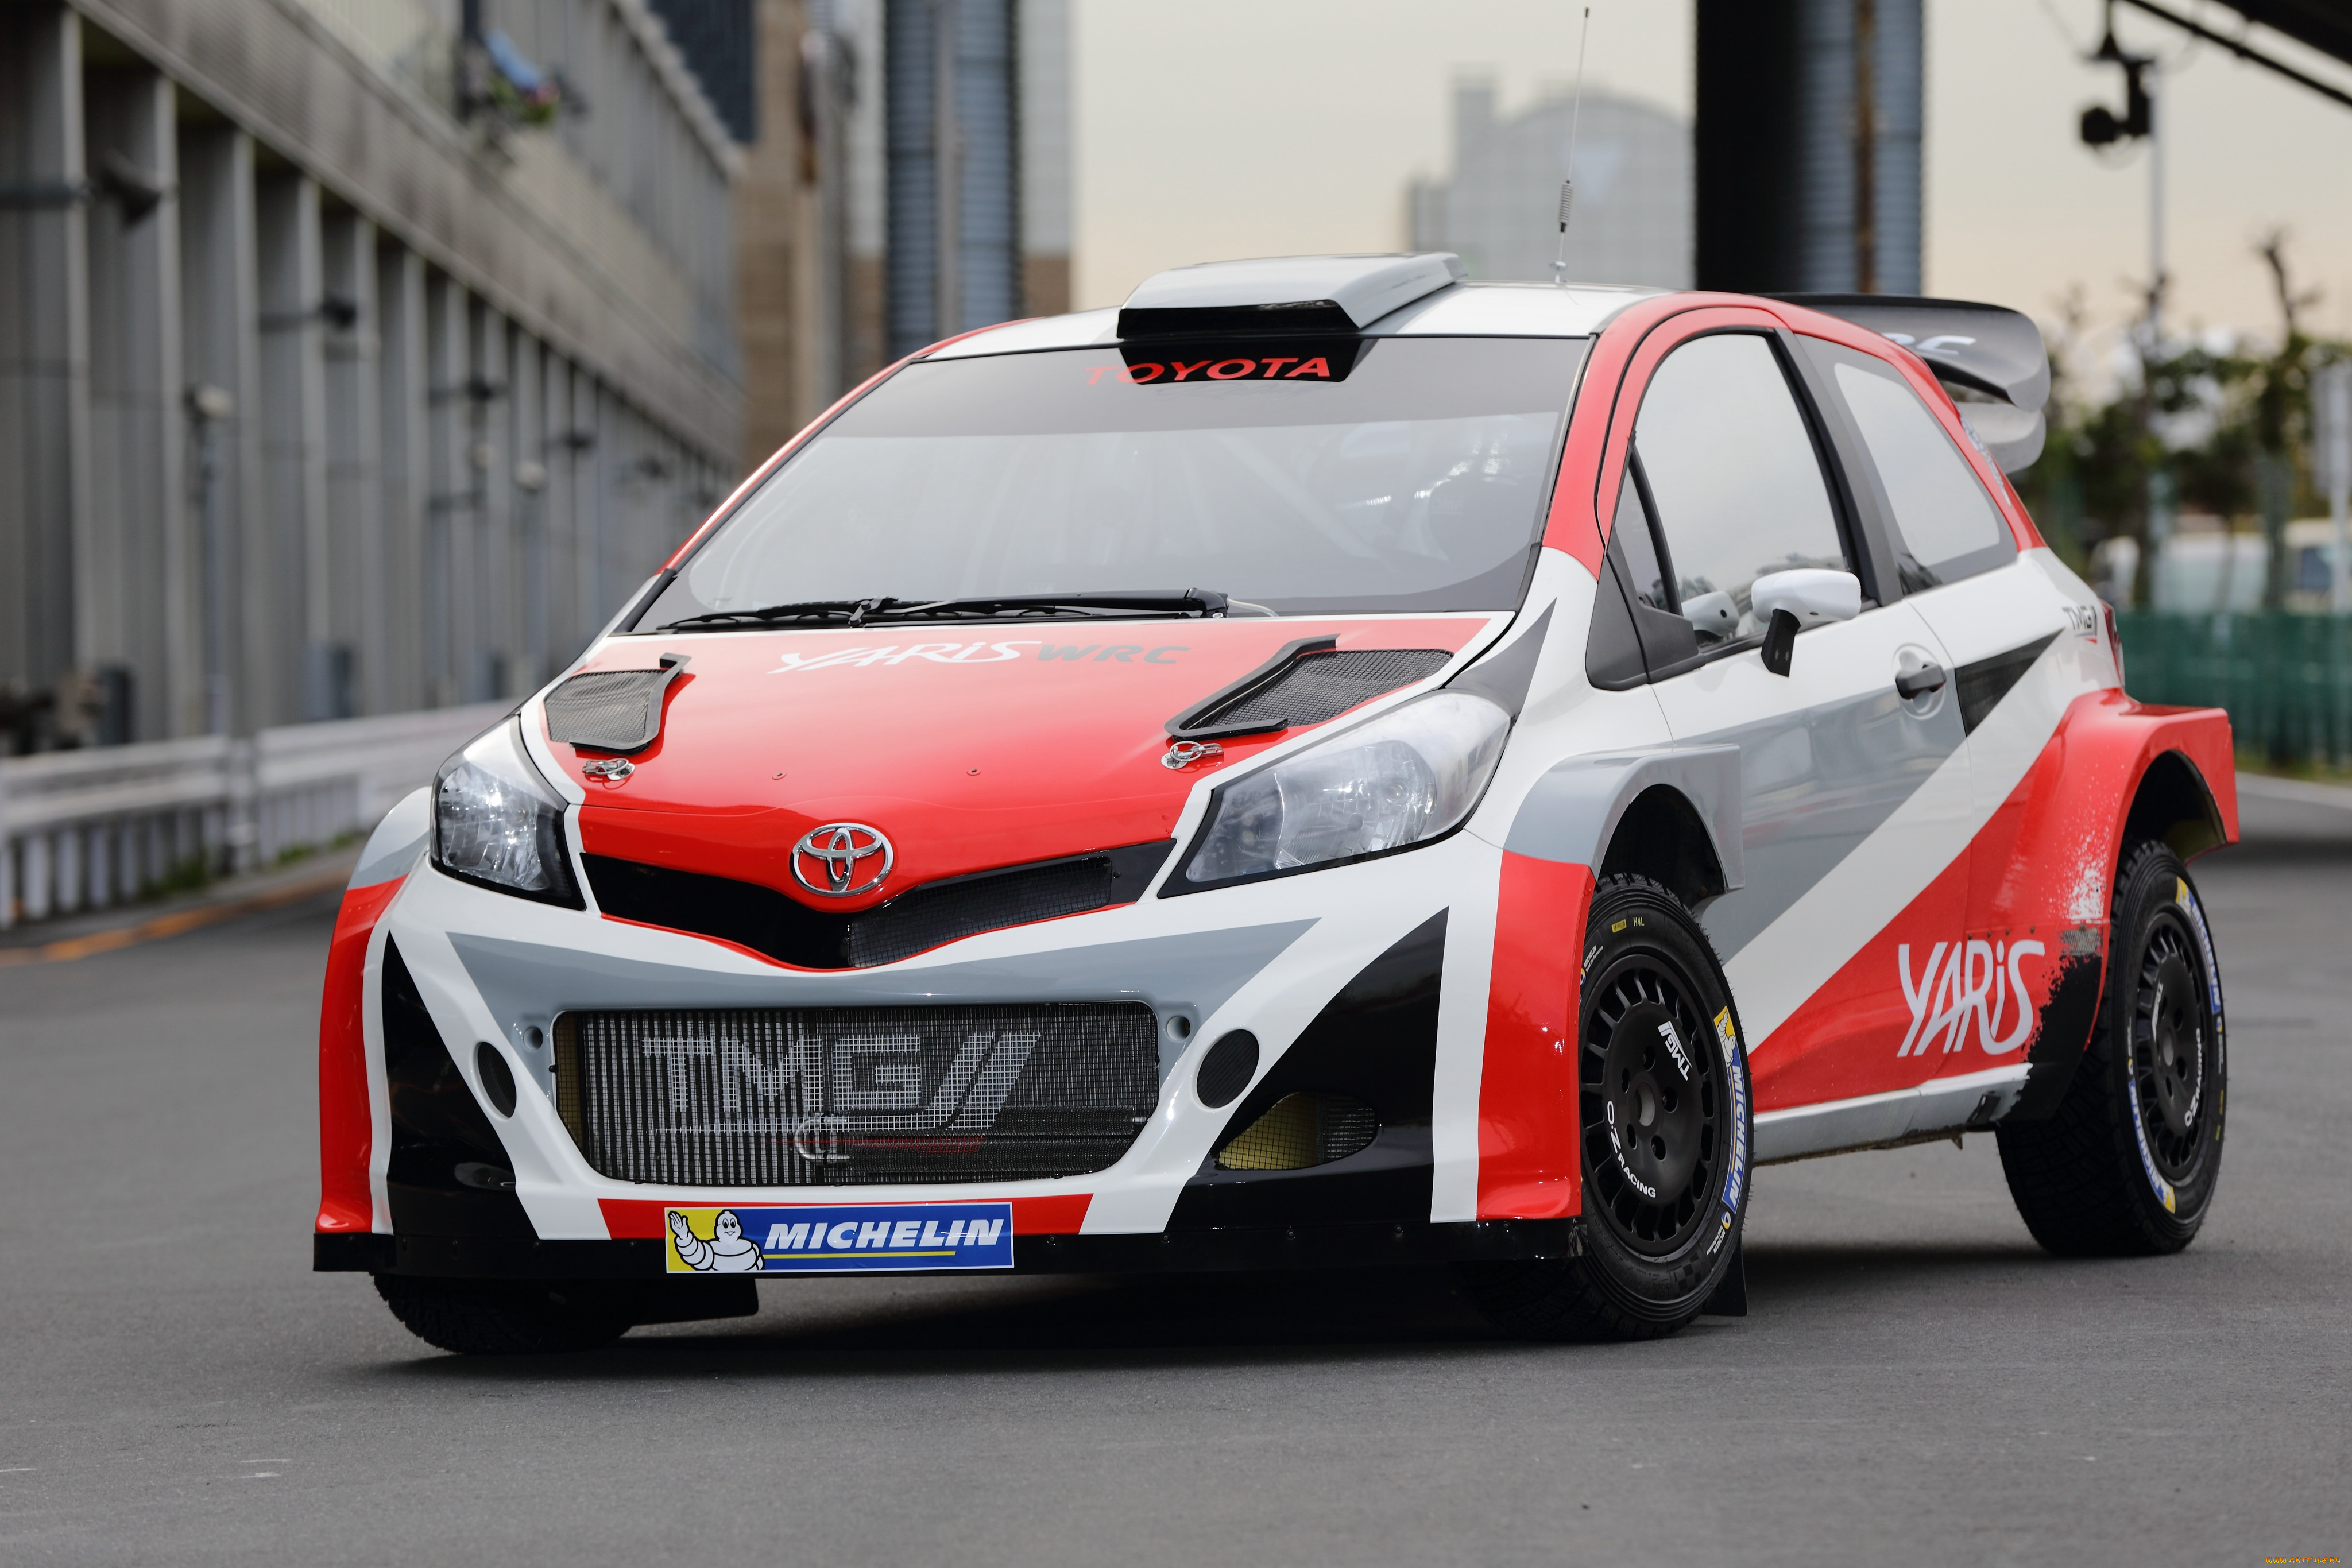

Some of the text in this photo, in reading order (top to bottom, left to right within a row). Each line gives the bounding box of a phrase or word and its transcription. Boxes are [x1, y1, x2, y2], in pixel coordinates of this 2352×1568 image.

[1085, 357, 1331, 386] TOYOTA
[1037, 644, 1190, 664] WRC
[643, 1034, 920, 1113] TMG
[1728, 1066, 1746, 1207] MICHELIN
[1618, 1153, 1656, 1198] RACING
[764, 1219, 1004, 1250] MICHELIN
